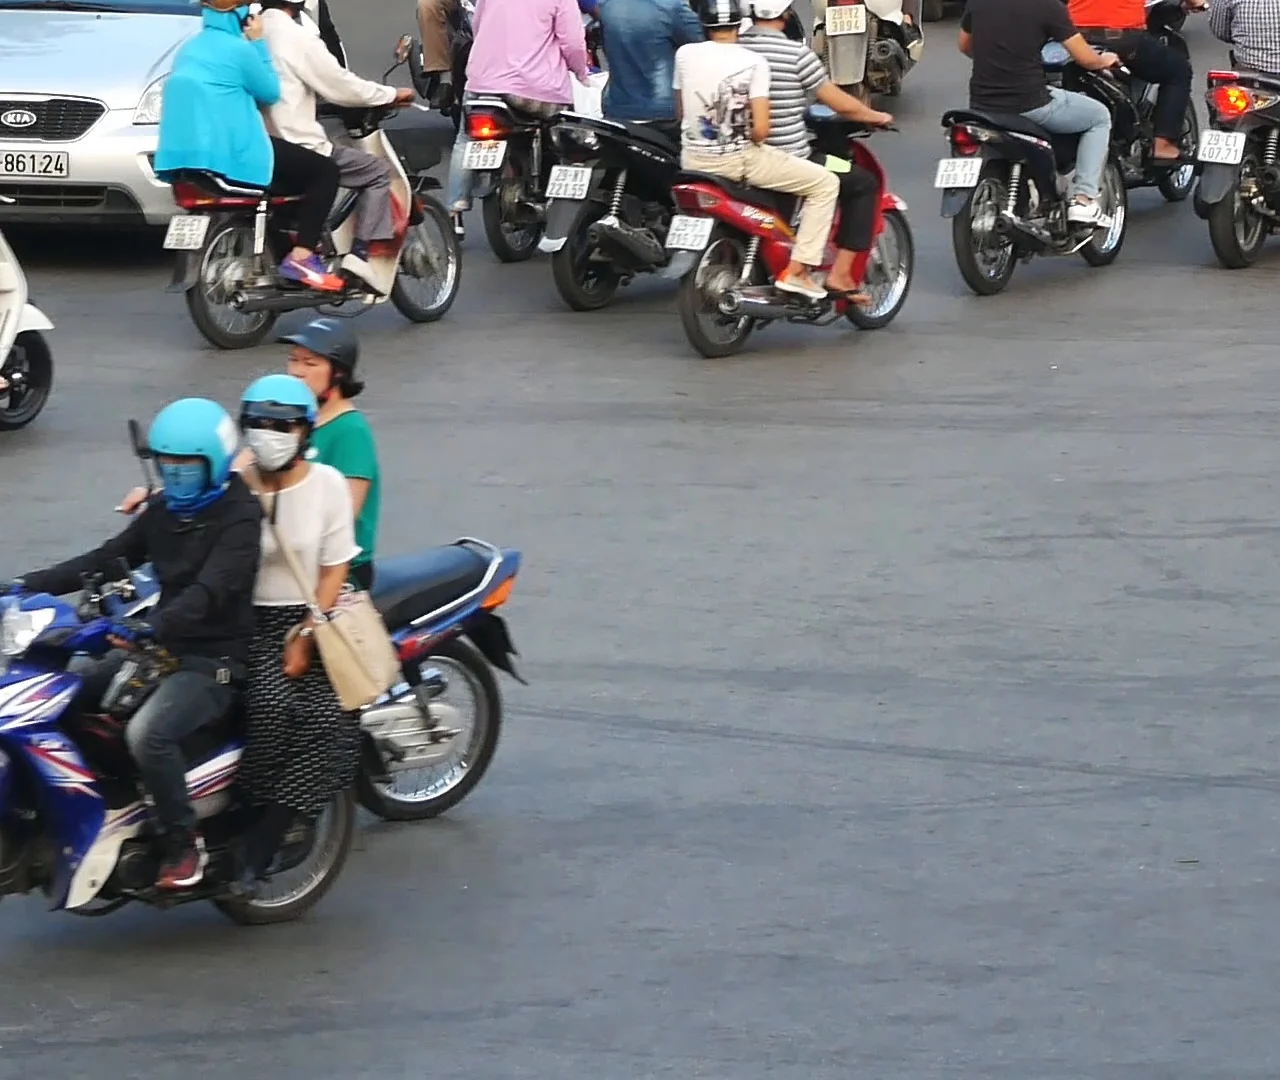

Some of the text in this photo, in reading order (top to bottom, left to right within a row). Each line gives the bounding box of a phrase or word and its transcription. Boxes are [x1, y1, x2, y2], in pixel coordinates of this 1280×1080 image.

[8, 114, 30, 123] KIA
[1207, 133, 1237, 147] 29-C1
[1202, 147, 1238, 161] 407.71
